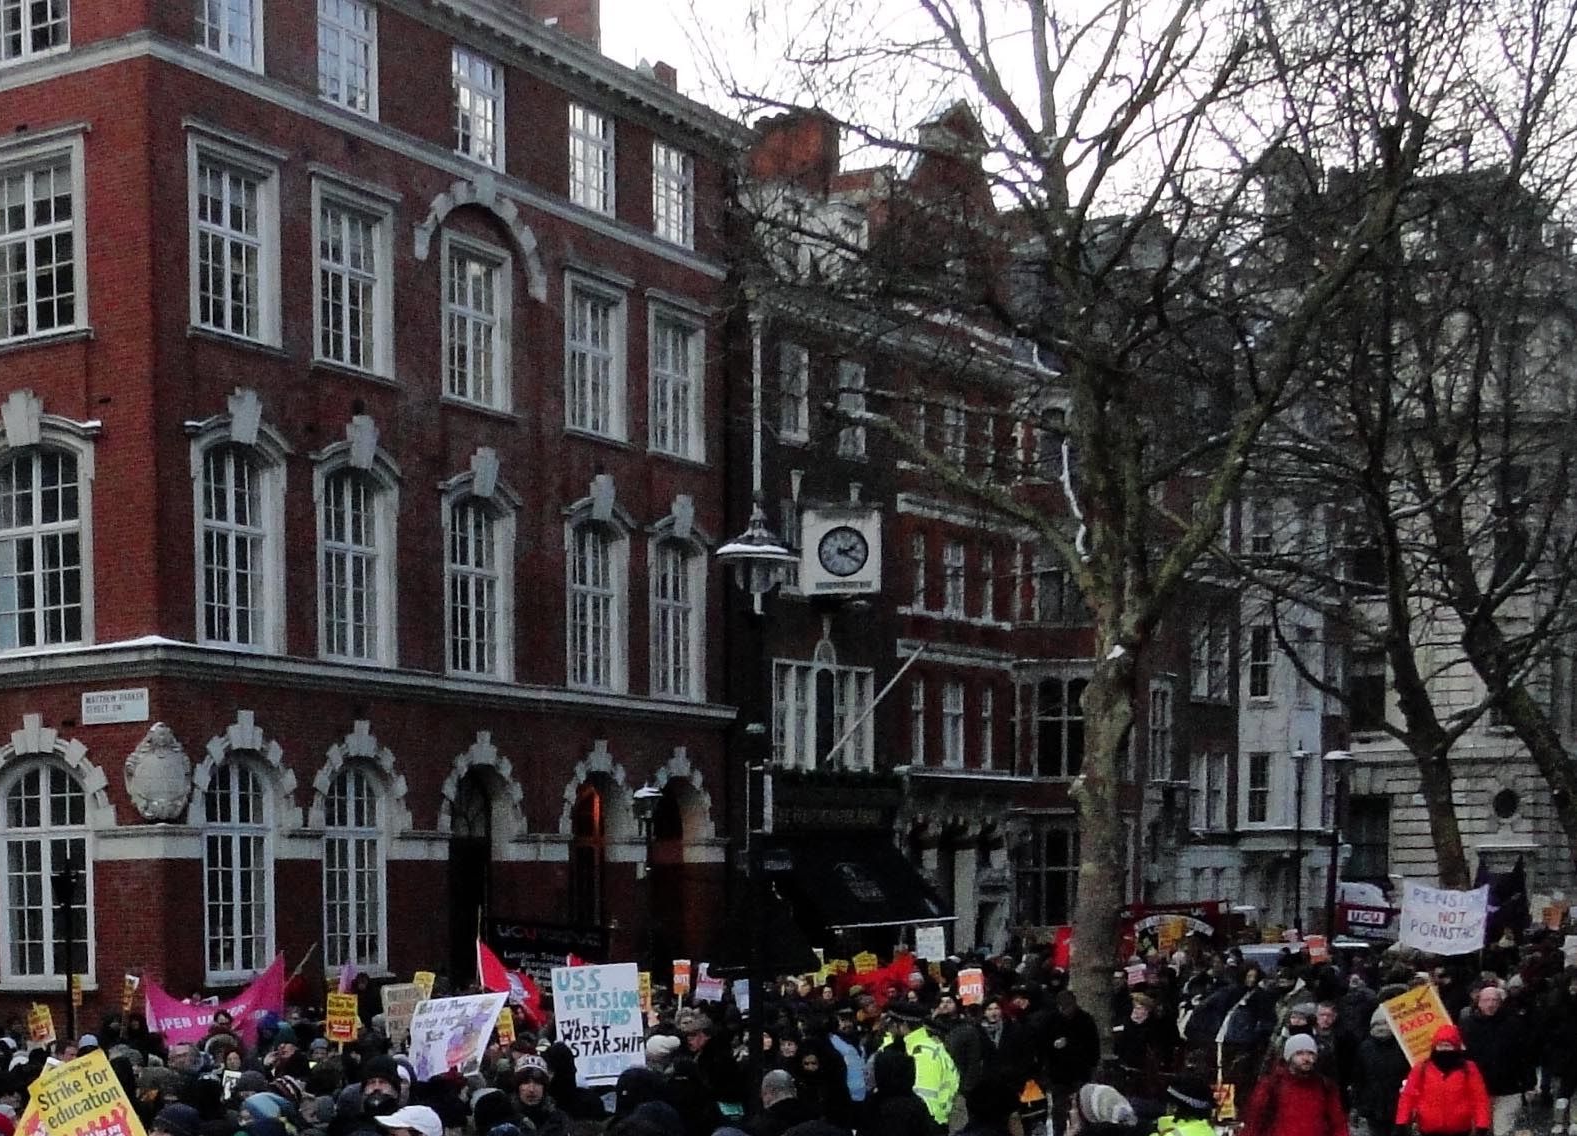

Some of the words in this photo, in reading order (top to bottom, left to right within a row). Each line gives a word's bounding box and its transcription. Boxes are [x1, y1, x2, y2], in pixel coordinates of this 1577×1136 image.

[1351, 911, 1380, 922] UCU
[556, 969, 601, 991] USS
[564, 988, 639, 1010] PENSION
[559, 1018, 580, 1028] THE
[591, 1010, 631, 1025] FUND
[561, 1025, 610, 1041] WORST
[571, 1033, 646, 1057] STARSHIP
[38, 1080, 83, 1111] Strike
[85, 1068, 108, 1086] for
[48, 1086, 121, 1129] education
